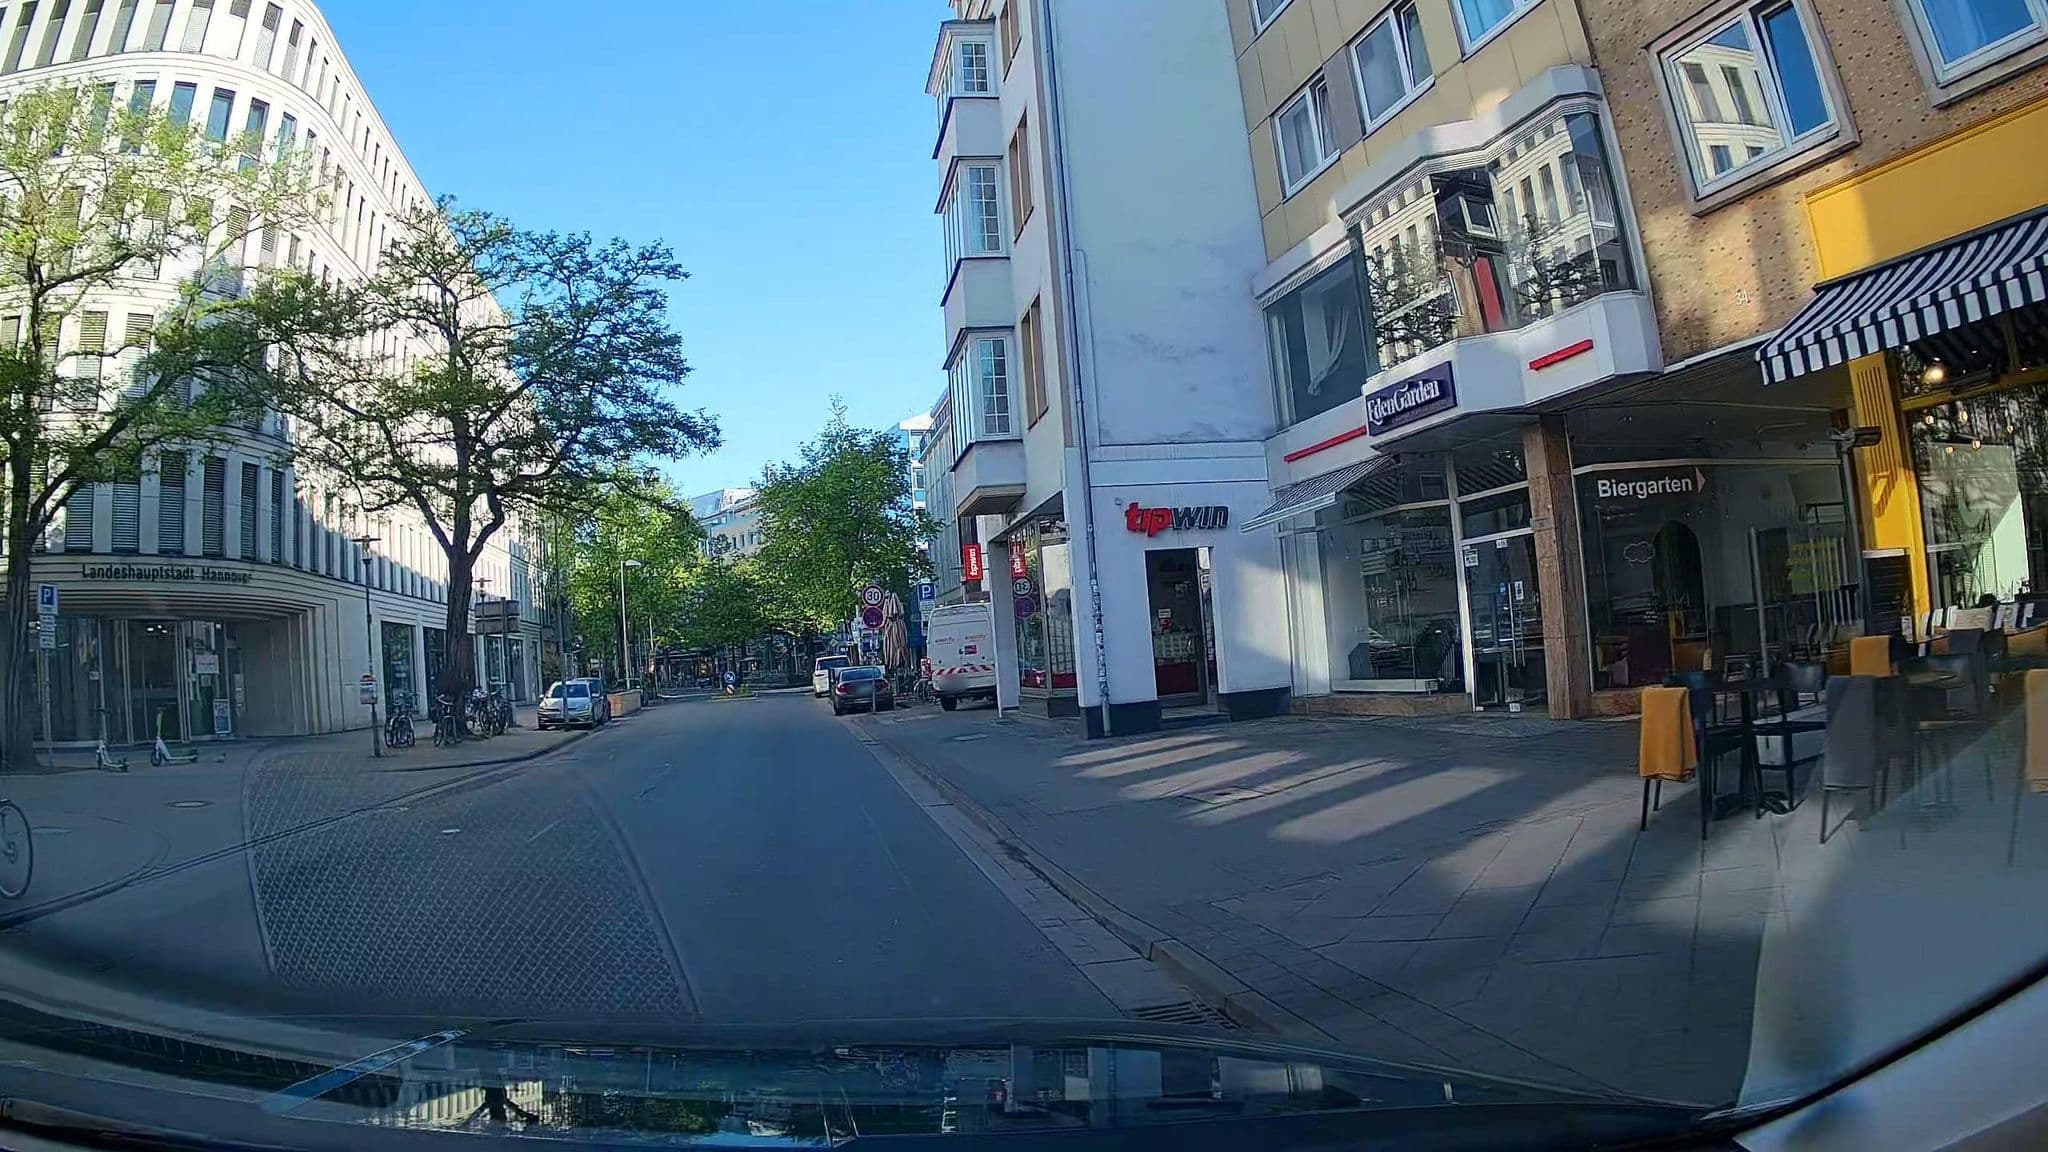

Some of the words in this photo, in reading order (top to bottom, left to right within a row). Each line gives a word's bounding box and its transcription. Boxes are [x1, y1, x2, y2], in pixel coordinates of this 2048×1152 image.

[1597, 476, 1692, 499] Biergarten
[1125, 502, 1229, 537] tipwin
[969, 548, 979, 576] tipwin
[82, 563, 195, 582] Landeshauptstadt
[201, 568, 252, 584] Hannover
[43, 588, 51, 603] P
[867, 591, 879, 601] 30
[921, 585, 931, 599] P
